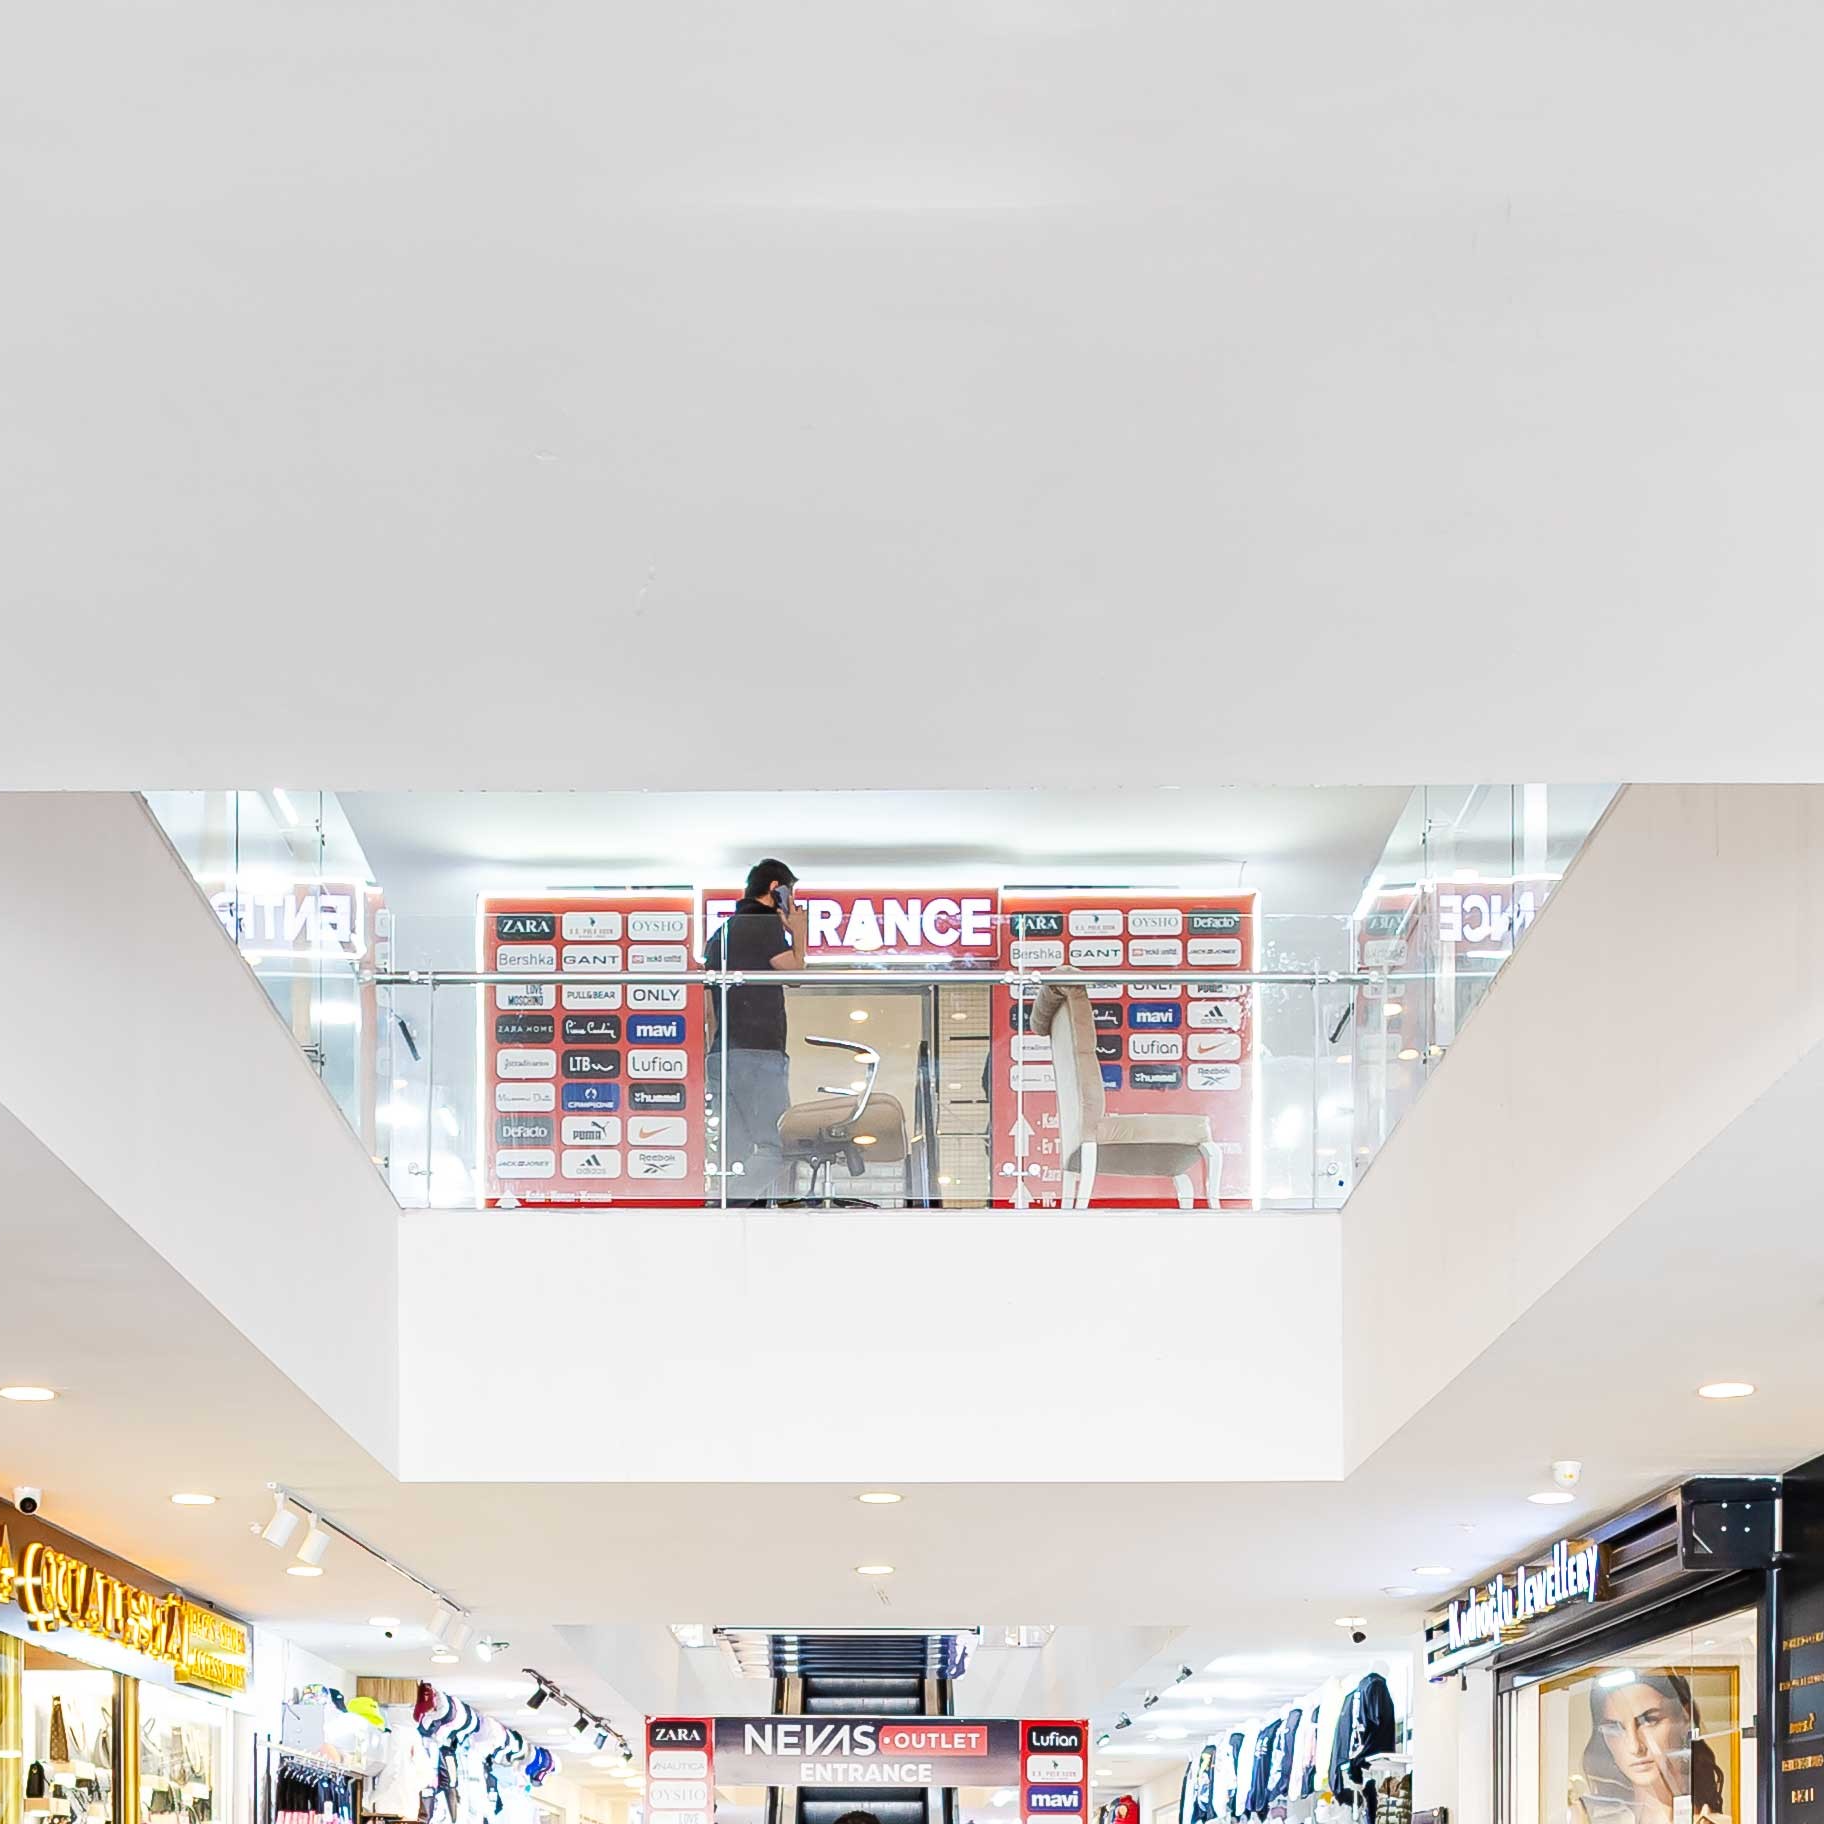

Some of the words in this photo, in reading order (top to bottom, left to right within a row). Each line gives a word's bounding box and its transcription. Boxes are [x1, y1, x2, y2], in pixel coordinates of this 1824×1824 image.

[501, 919, 550, 934] ZARA
[632, 920, 683, 932] OYSHO
[1016, 916, 1058, 930] ZARA
[1132, 917, 1178, 928] OYSHO
[1193, 917, 1234, 928] DeFacto
[499, 953, 554, 966] Bershka
[563, 955, 619, 964] GANT
[1012, 948, 1062, 959] Bershka
[1070, 949, 1120, 958] GANT
[567, 990, 615, 1000] PULL&BEAR
[633, 988, 680, 1002] ONLY
[1137, 1010, 1172, 1022] mavi
[498, 1025, 523, 1033] ZARA
[527, 1025, 553, 1033] HOME
[637, 1022, 676, 1037] mavi
[1133, 1040, 1178, 1054] Lufian
[569, 1057, 590, 1071] LTB
[633, 1056, 683, 1072] Lufian
[503, 1126, 547, 1137] DeFacto
[573, 1130, 601, 1140] PUMA
[639, 1154, 675, 1162] Reebok
[656, 1728, 701, 1741] ZARA
[894, 1733, 980, 1749] OUTLET
[1032, 1732, 1077, 1746] Lufian
[801, 1763, 932, 1782] ENTRANCE
[651, 1788, 705, 1801] OYSHO
[1031, 1791, 1078, 1807] mavi
